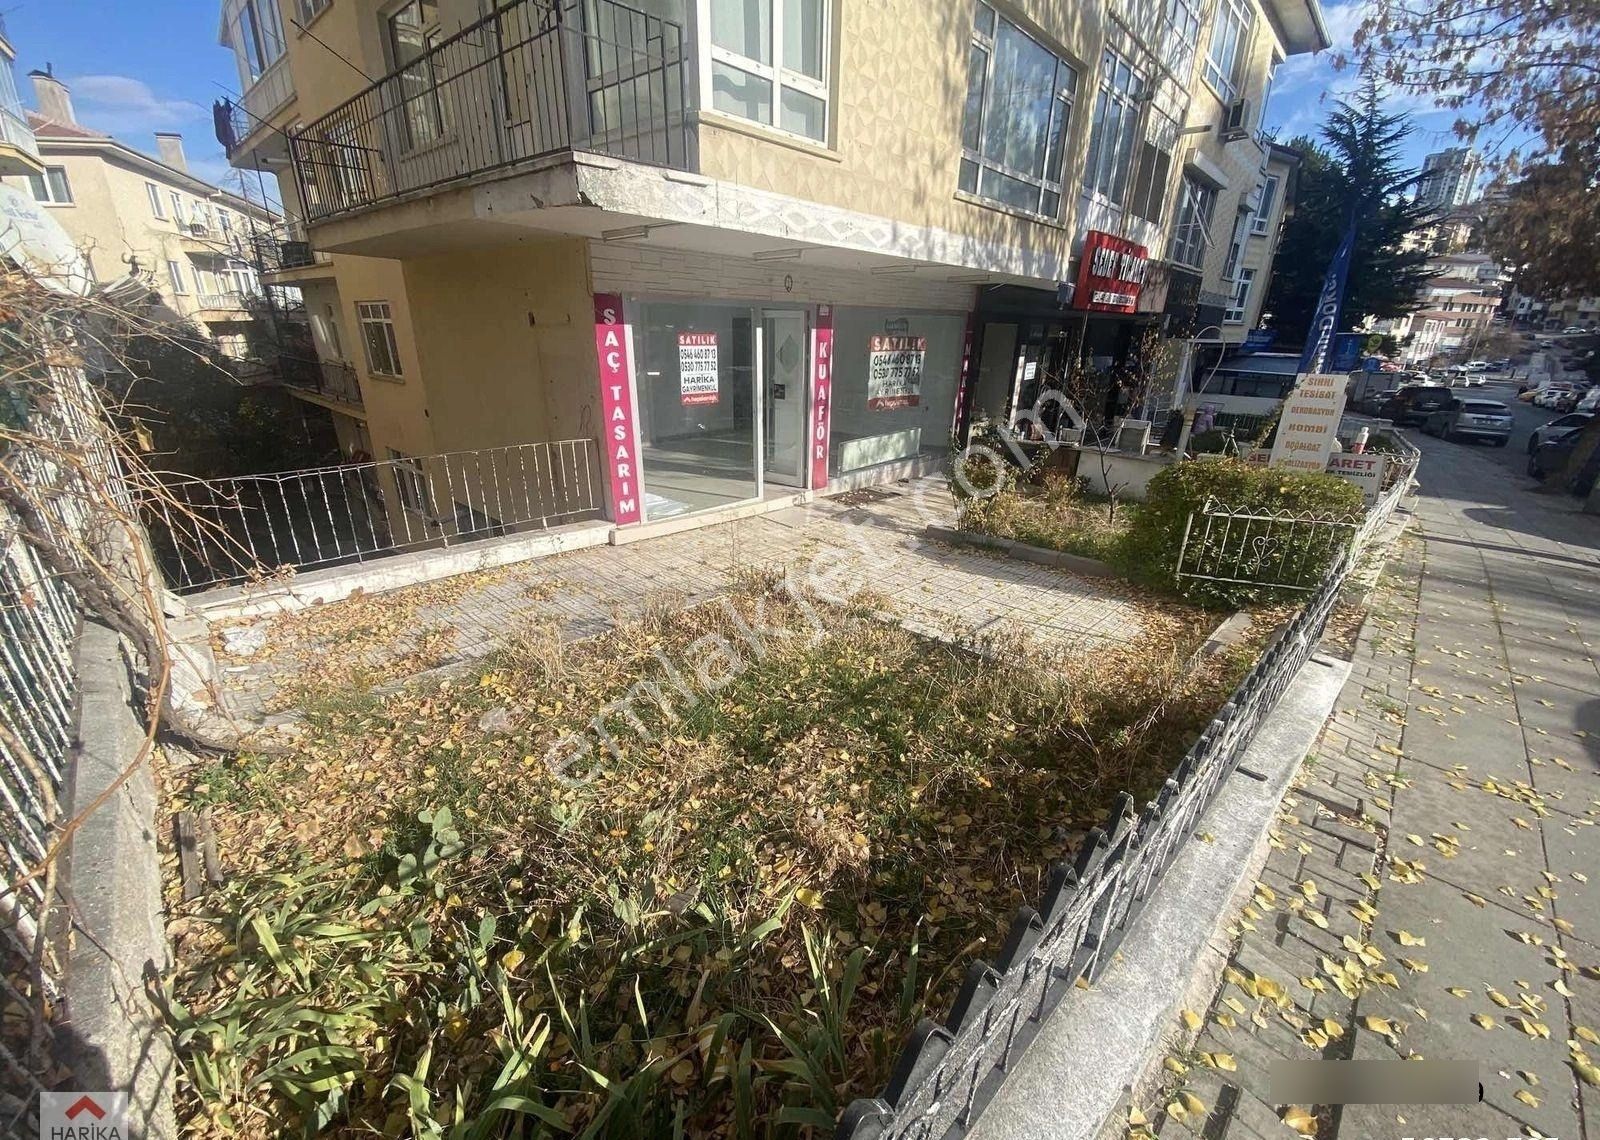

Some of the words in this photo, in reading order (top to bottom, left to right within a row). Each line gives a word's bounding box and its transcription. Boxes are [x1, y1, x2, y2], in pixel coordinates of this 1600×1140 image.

[603, 308, 620, 374] SAÇ
[679, 335, 716, 345] SATILIK
[874, 337, 927, 351] SATILIK
[680, 361, 694, 372] 0530
[695, 361, 703, 371] 775
[704, 361, 710, 371] 77
[710, 361, 716, 371] 52
[891, 367, 903, 377] 775
[903, 367, 912, 378] 77
[683, 374, 715, 384] HARİKA
[816, 342, 828, 459] KUAFÖR
[610, 385, 635, 515] TASARIM
[1328, 458, 1377, 471] ARET
